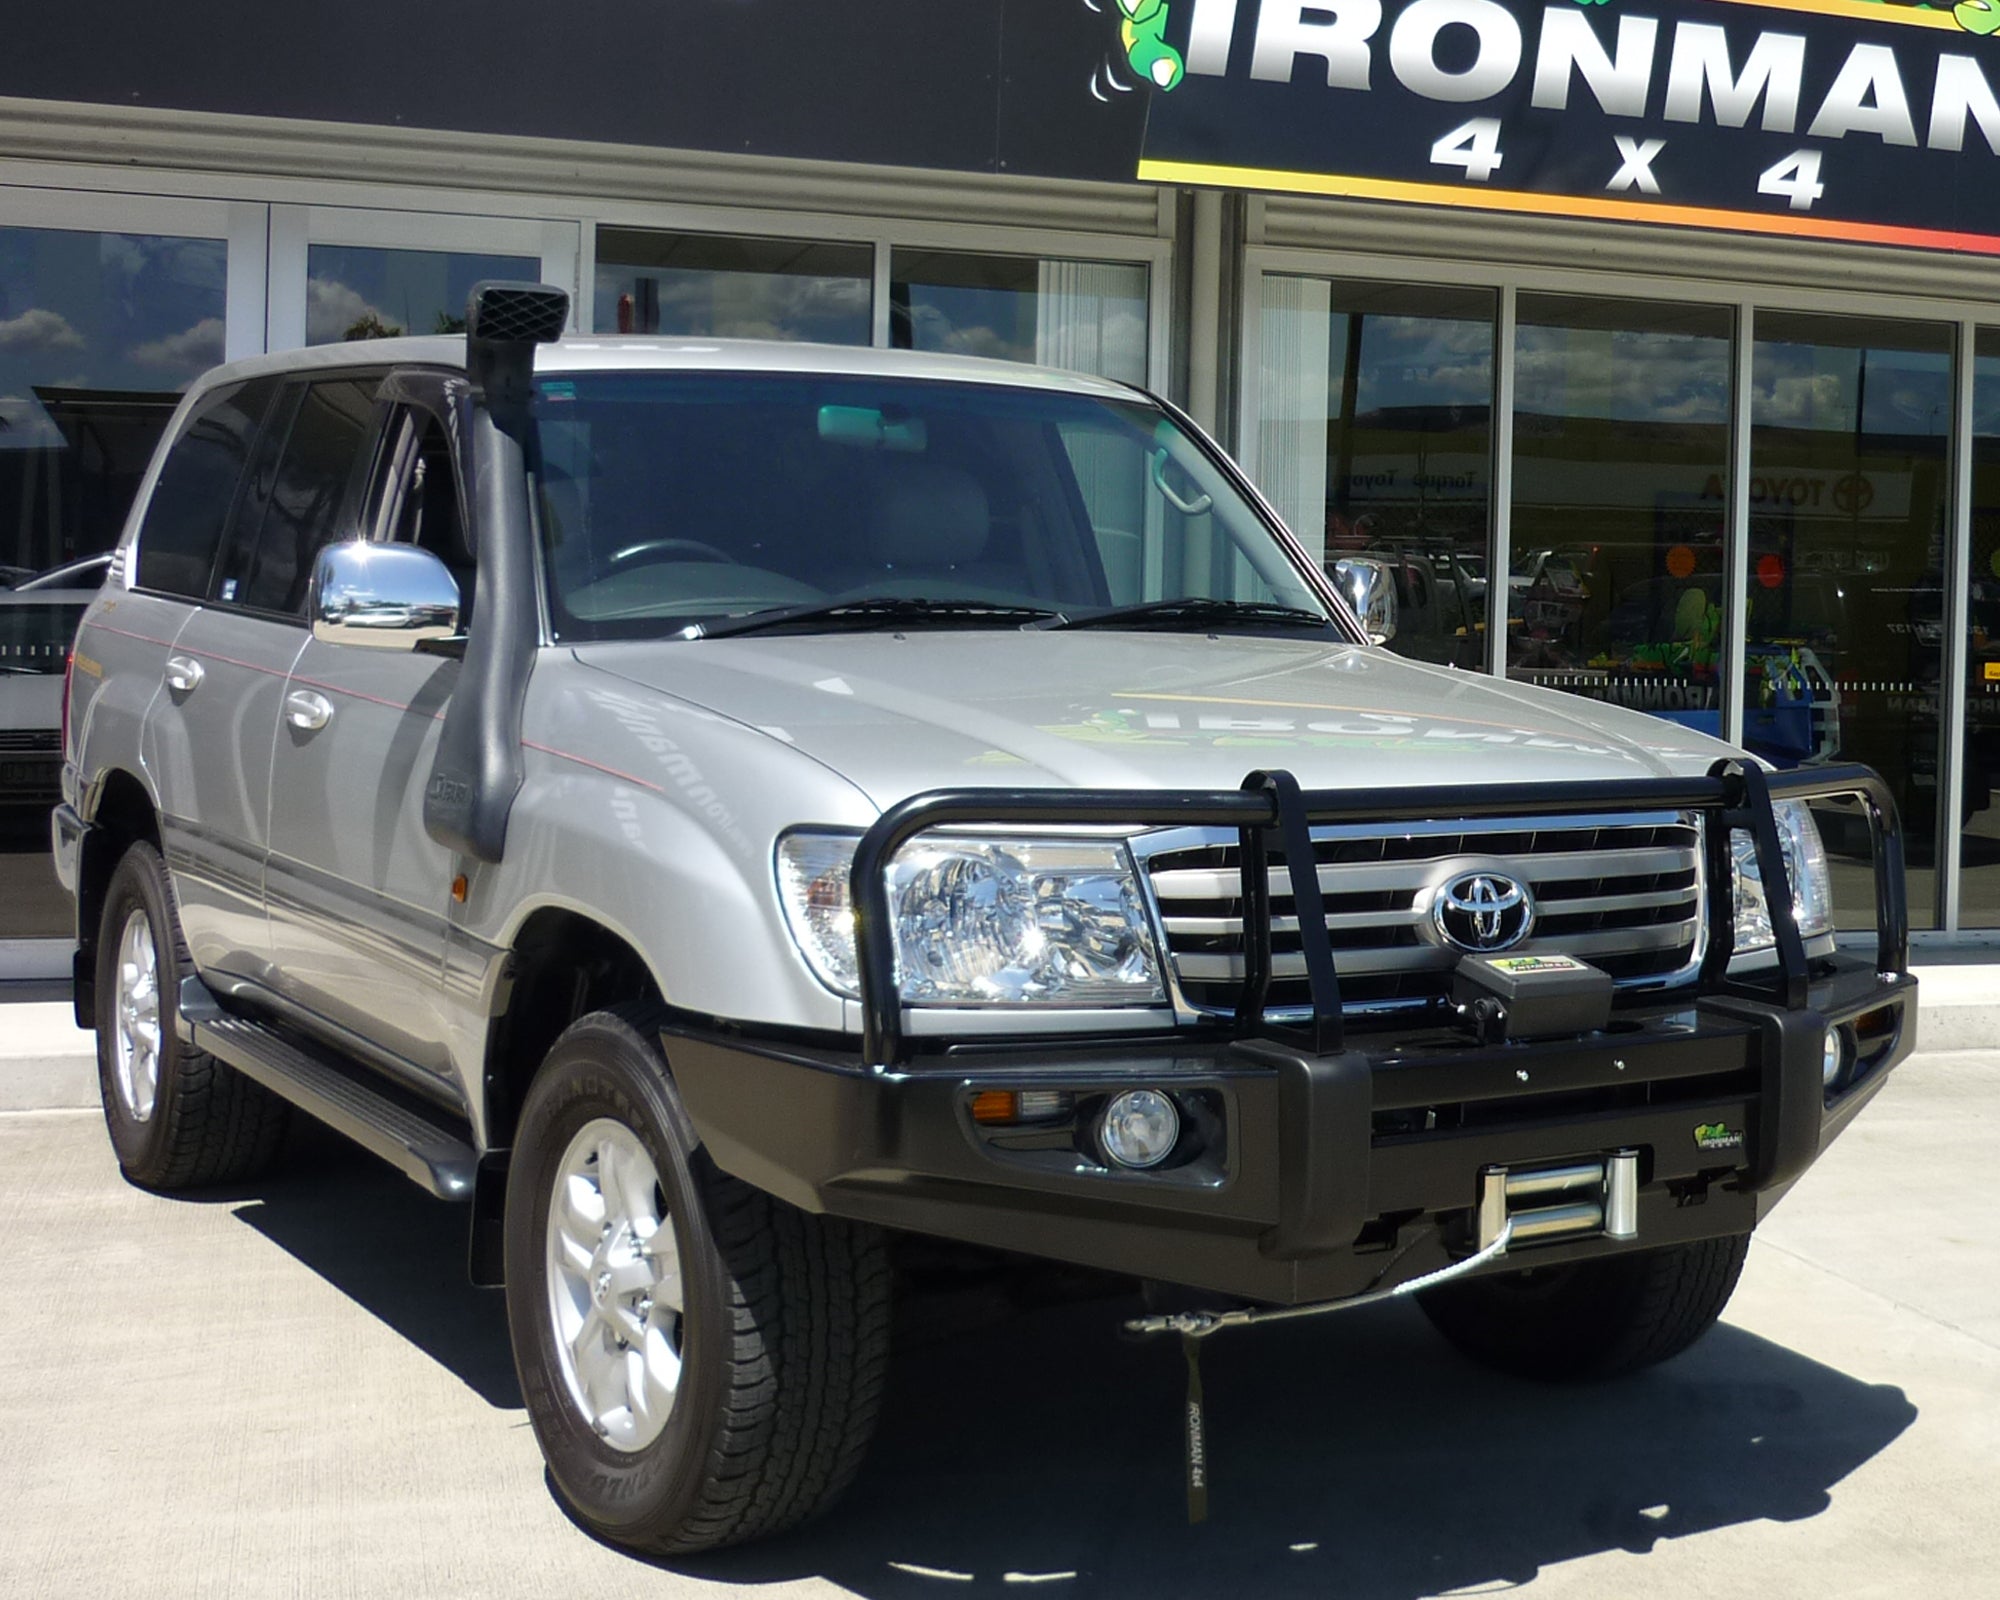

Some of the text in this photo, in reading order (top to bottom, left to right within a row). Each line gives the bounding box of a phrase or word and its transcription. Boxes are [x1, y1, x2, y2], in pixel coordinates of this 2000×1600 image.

[1185, 0, 2000, 152] IRONMAN
[1429, 117, 1503, 181] 4
[1757, 149, 1824, 211] 4
[1189, 1402, 1204, 1488] IRONMAN 4x4
